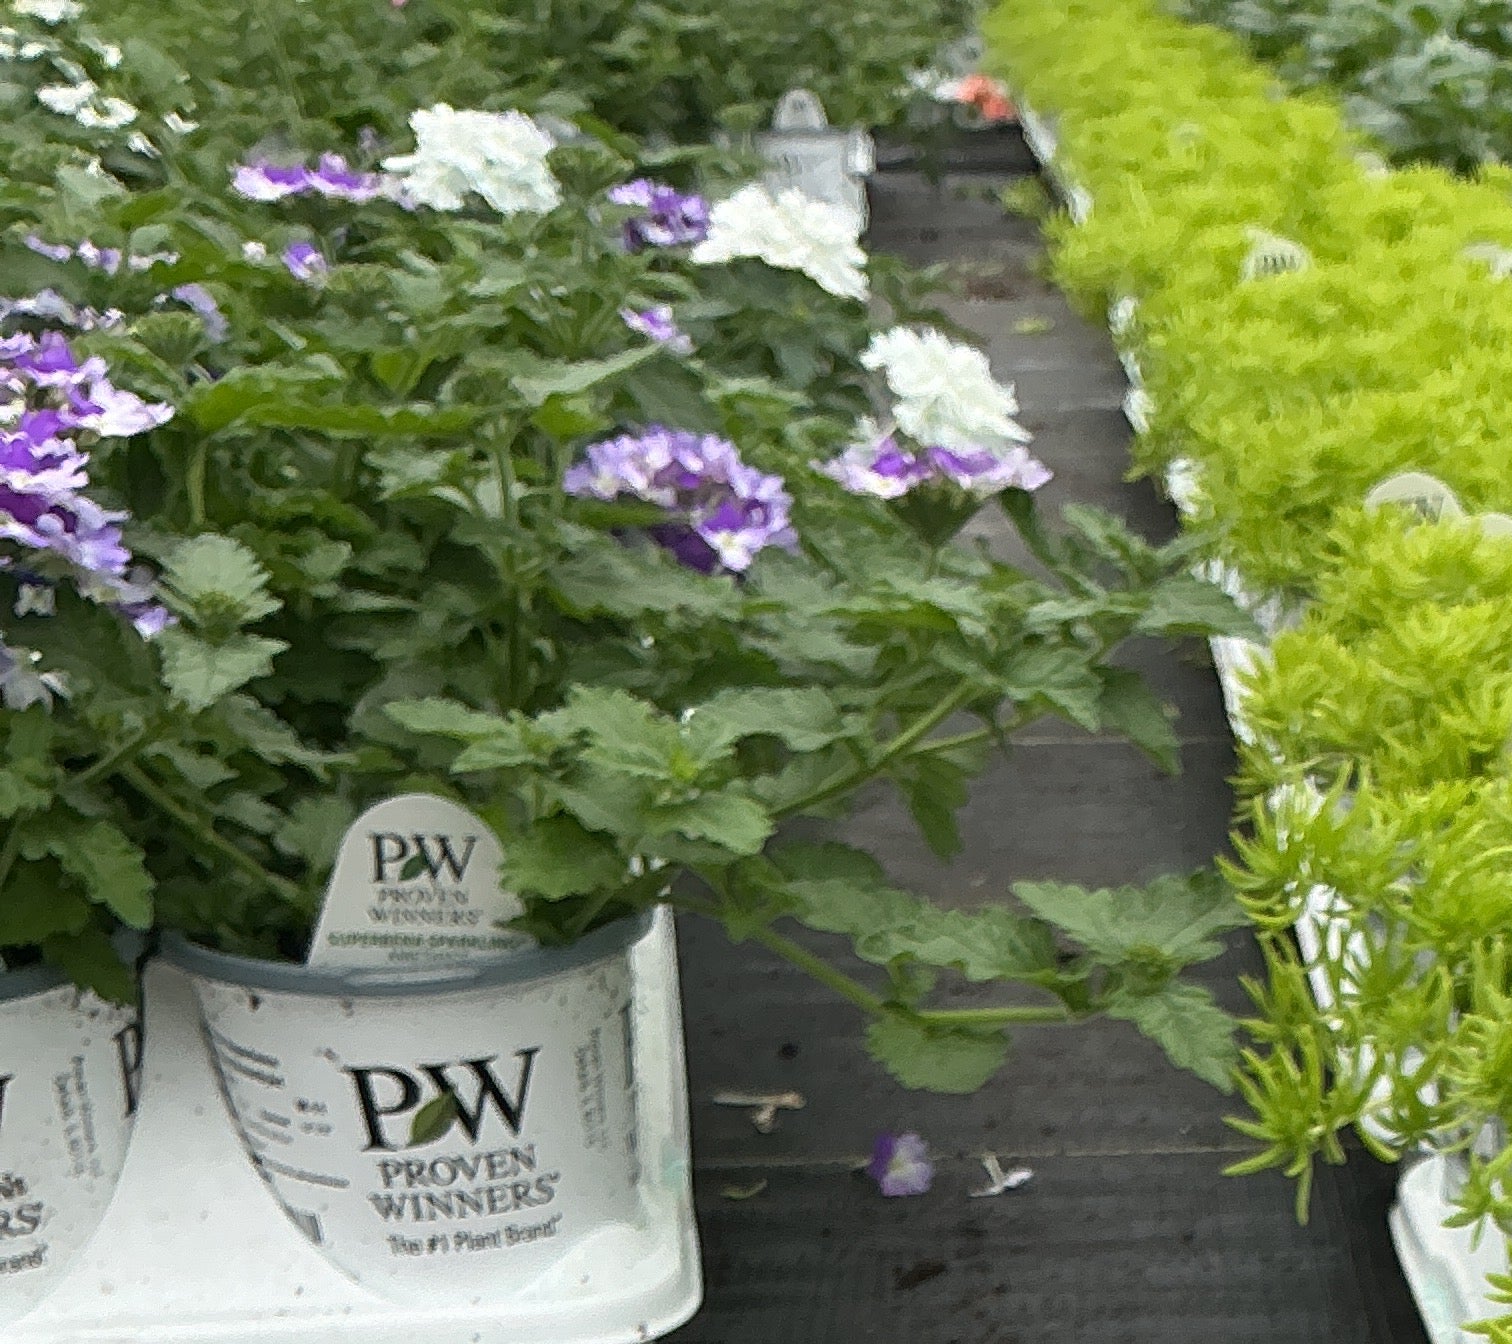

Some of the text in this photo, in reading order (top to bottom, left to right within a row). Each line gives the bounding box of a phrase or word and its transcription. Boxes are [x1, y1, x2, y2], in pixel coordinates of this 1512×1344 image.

[367, 830, 480, 884] PW
[341, 1045, 544, 1154] PW
[375, 1143, 539, 1191] PROVEN
